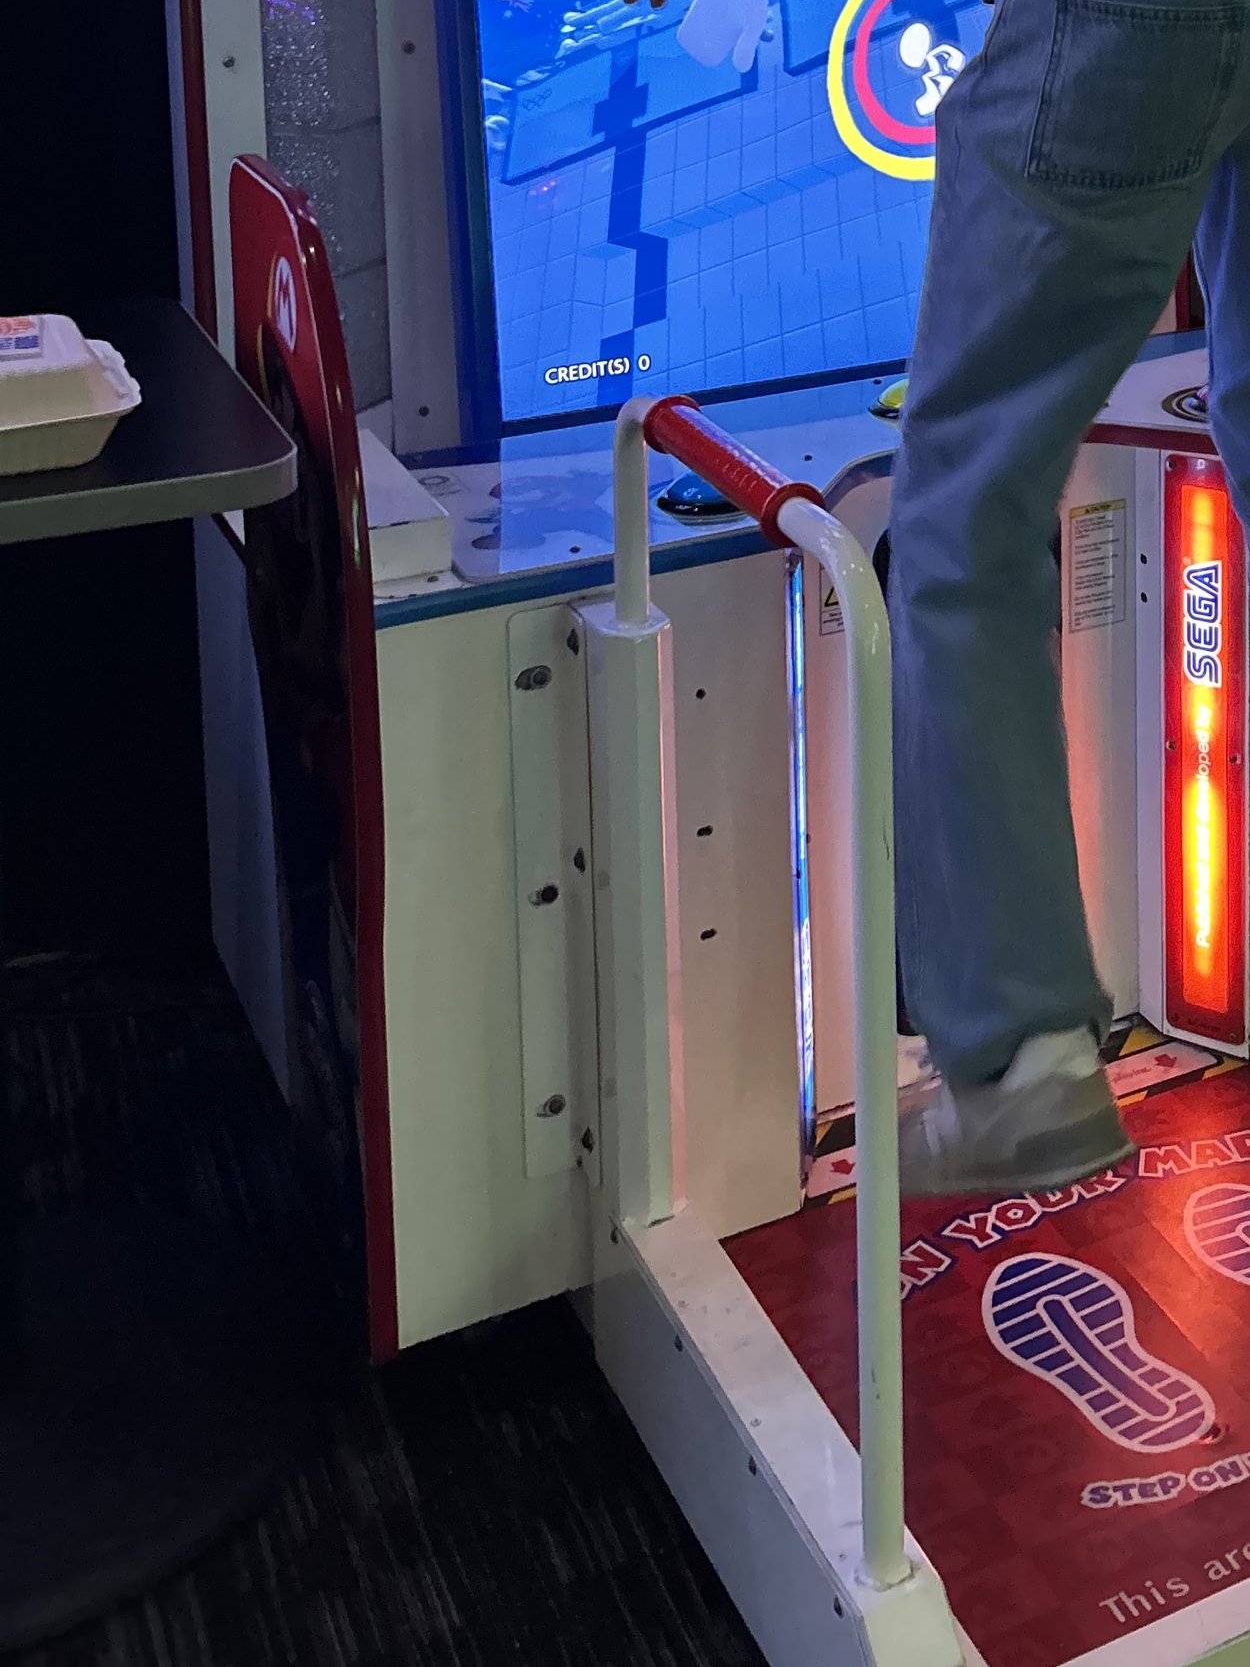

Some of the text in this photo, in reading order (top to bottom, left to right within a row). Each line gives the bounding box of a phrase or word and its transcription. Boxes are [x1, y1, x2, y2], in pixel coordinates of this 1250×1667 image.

[544, 355, 651, 384] CREDIT(S) 0
[1183, 560, 1222, 688] SEGA
[1081, 1472, 1186, 1508] STEP
[1188, 1454, 1250, 1493] ON
[1099, 1574, 1190, 1625] This
